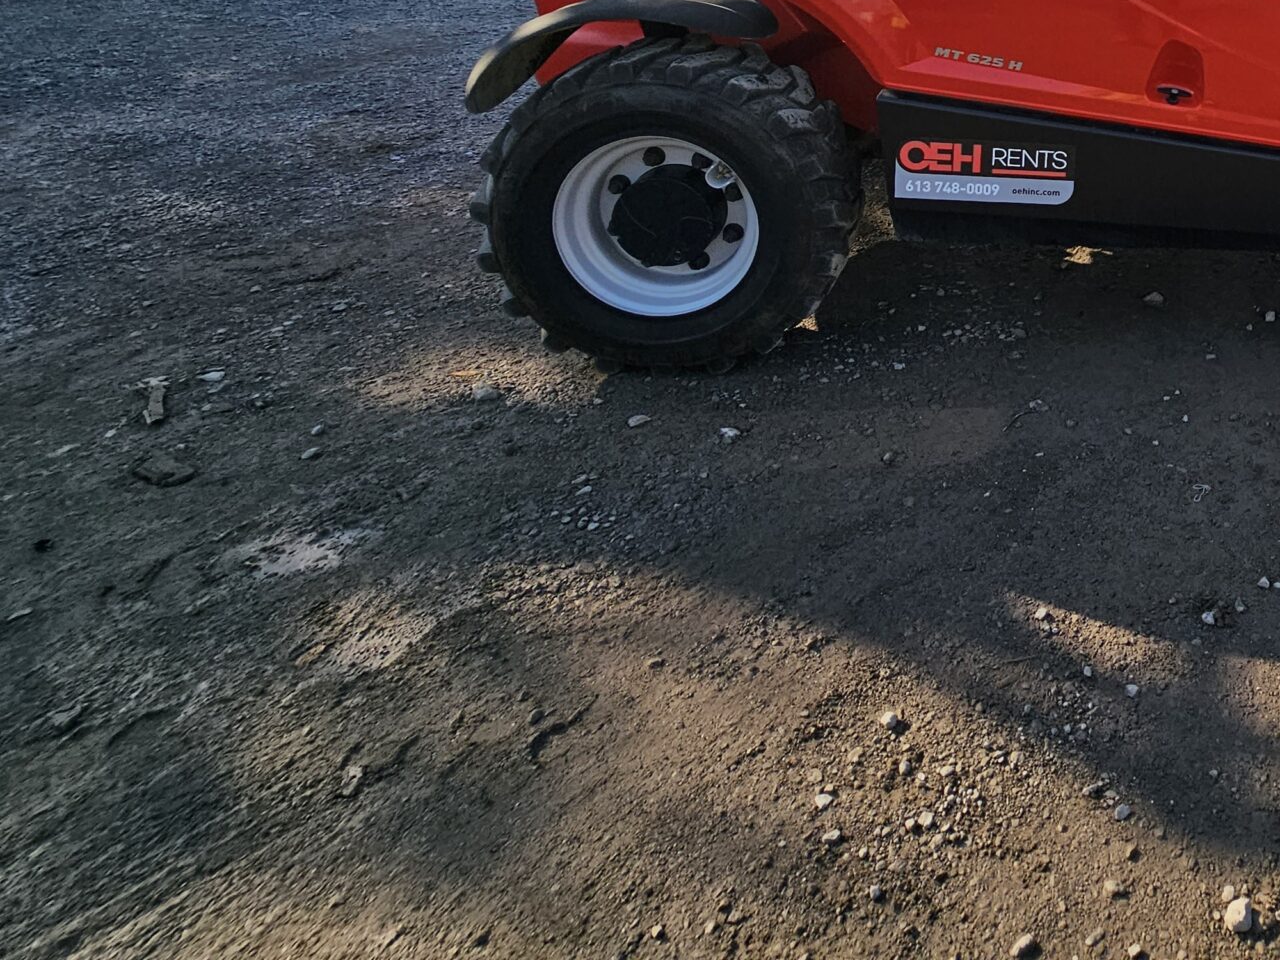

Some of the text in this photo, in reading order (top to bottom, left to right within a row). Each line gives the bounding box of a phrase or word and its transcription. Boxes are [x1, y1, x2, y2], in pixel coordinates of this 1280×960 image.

[934, 47, 1023, 71] MT 625 H
[899, 140, 1068, 173] OEH RENTS
[905, 179, 1000, 196] 613 748-0009
[1011, 187, 1061, 197] oehinc.com
